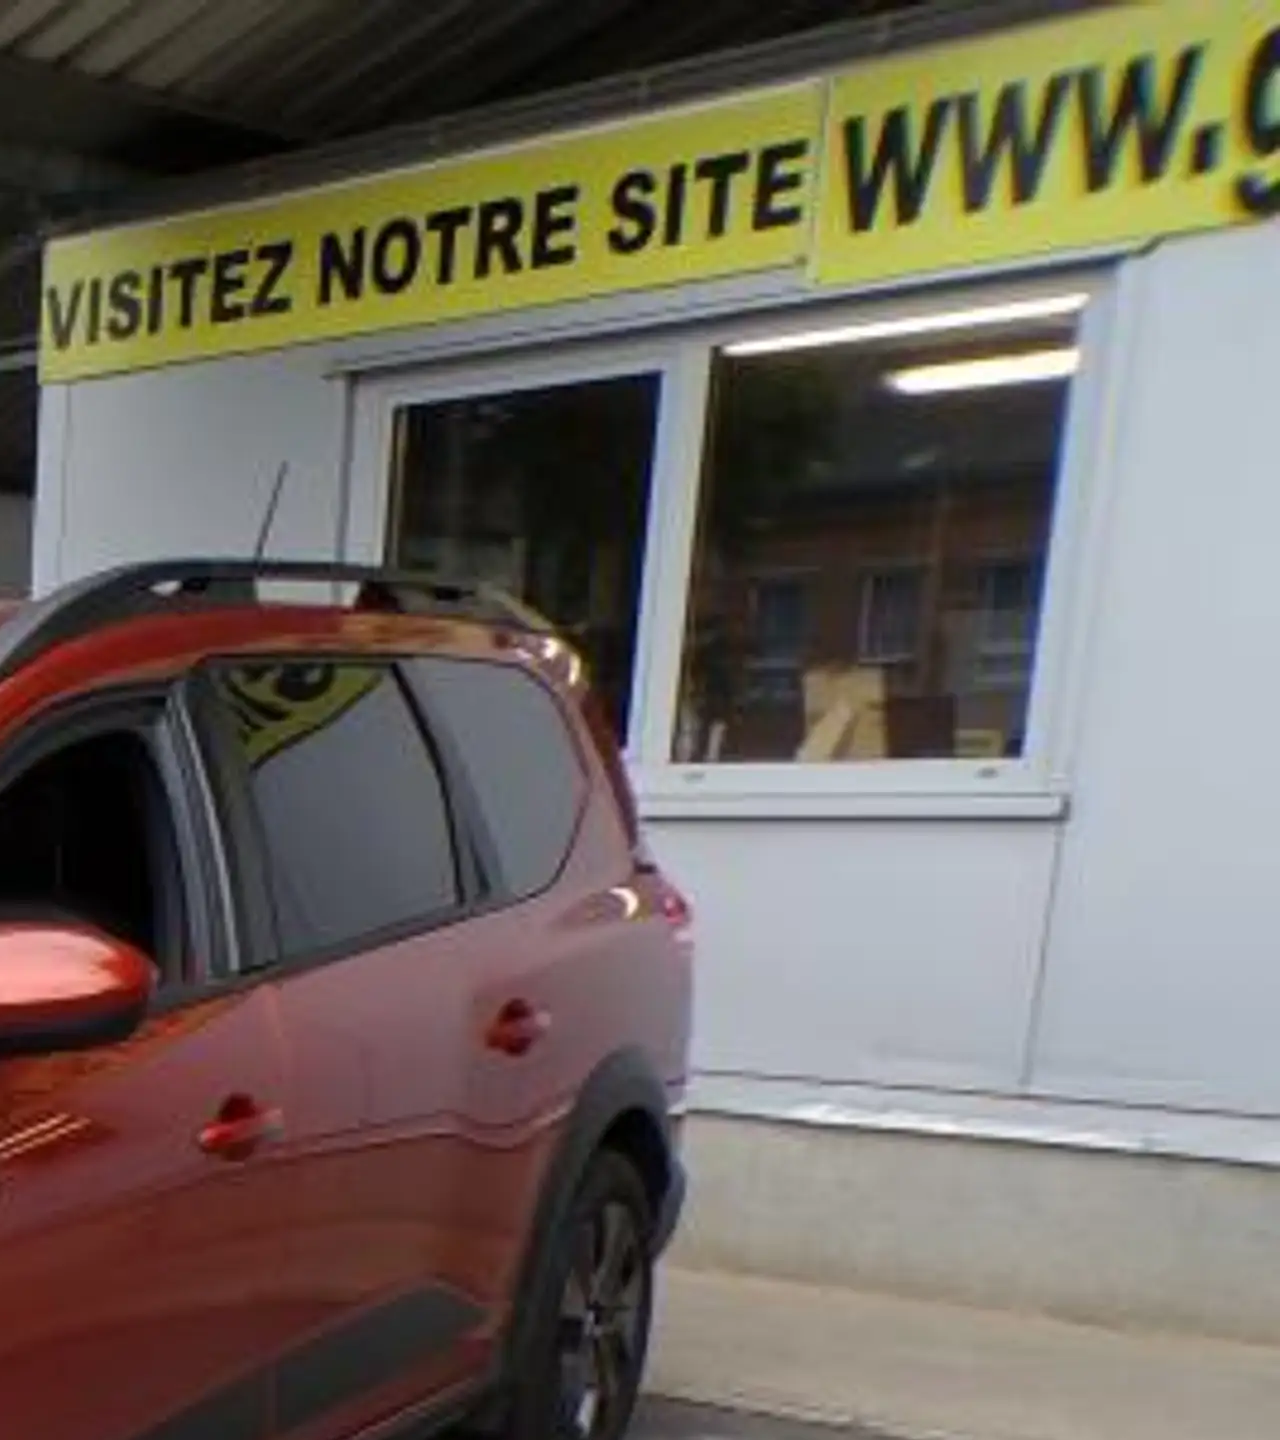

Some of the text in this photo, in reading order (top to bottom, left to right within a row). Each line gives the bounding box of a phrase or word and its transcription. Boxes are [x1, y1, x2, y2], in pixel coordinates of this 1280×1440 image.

[43, 139, 809, 351] VISITEZ NOTRE SITE
